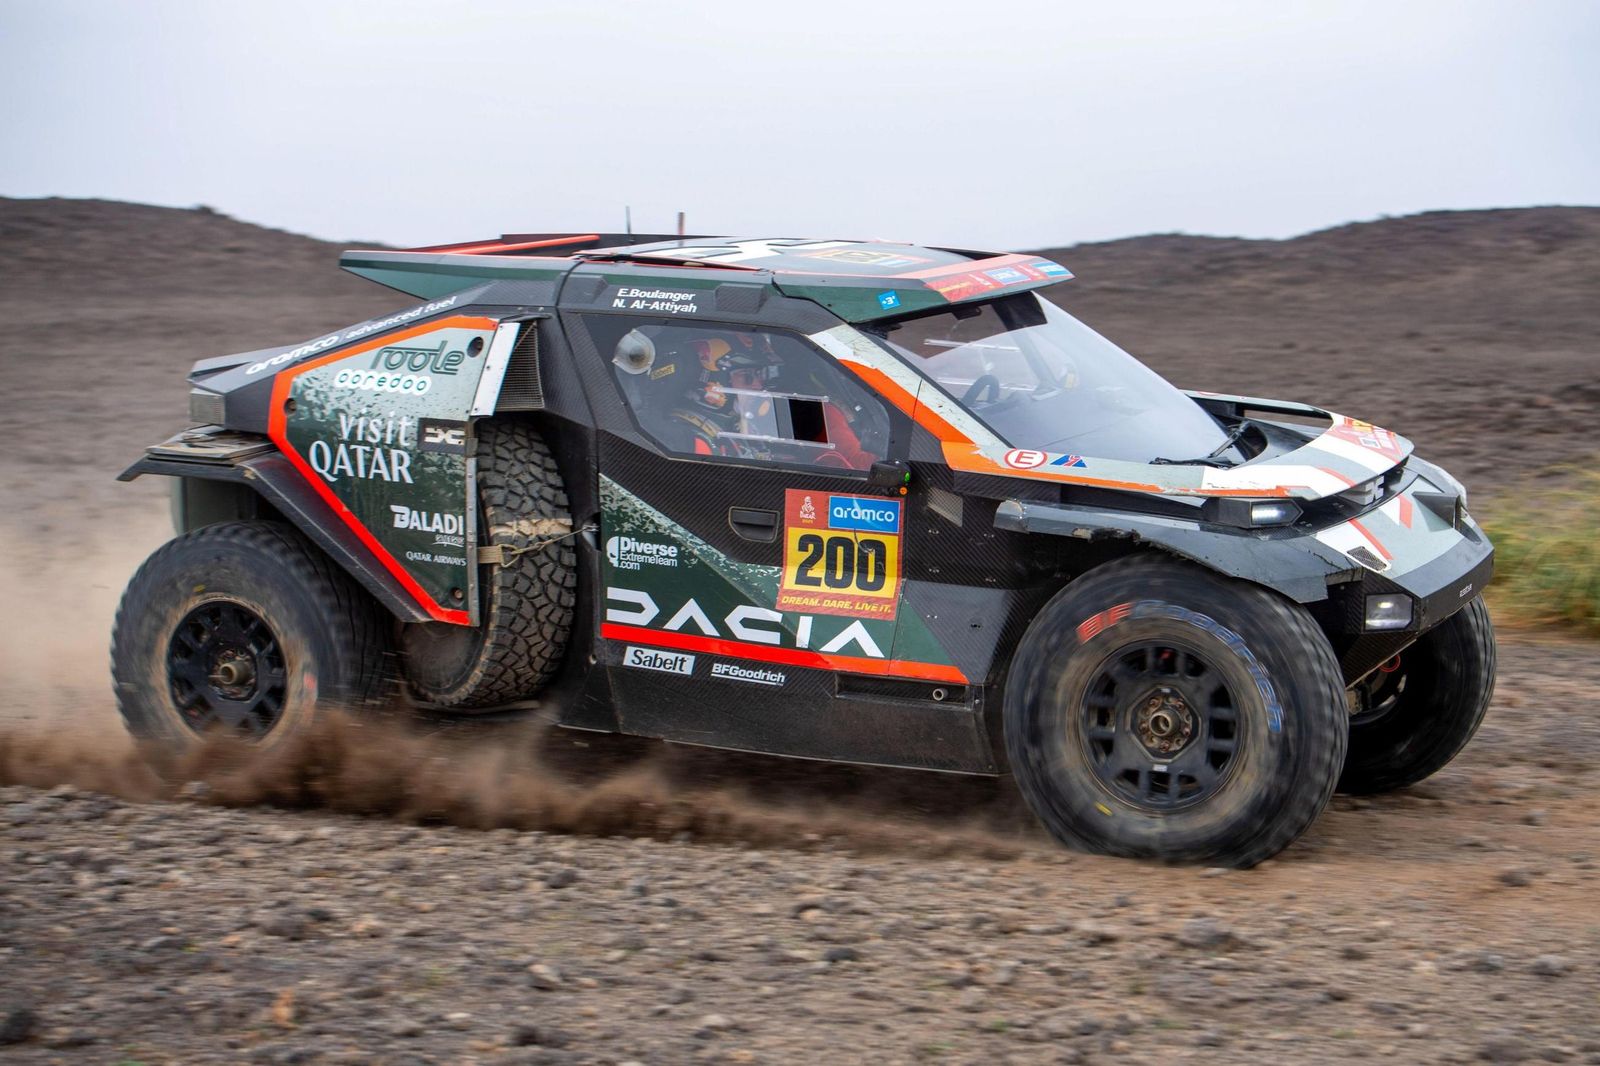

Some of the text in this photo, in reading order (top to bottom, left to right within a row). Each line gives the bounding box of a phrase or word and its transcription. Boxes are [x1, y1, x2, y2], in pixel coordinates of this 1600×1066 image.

[612, 298, 698, 313] N. Al-Attiyah
[245, 296, 458, 375] aramco advanced fuel
[336, 370, 430, 394] ooredoo
[339, 410, 413, 446] visit
[309, 440, 415, 484] QATAR
[1014, 451, 1037, 465] E
[390, 504, 465, 535] BALADI
[833, 507, 895, 522] aramco
[620, 536, 678, 557] Diverse
[406, 551, 467, 566] QATAR AIRWAYS
[619, 561, 640, 570] .com
[620, 550, 678, 567] ExtremeTeam
[795, 534, 887, 591] 200
[781, 595, 820, 607] DREAM.
[822, 599, 852, 610] DARE.
[855, 602, 880, 612] LIVE
[607, 586, 885, 658] DACIA
[631, 649, 687, 671] Sabelt
[711, 663, 786, 683] BFGoodrich
